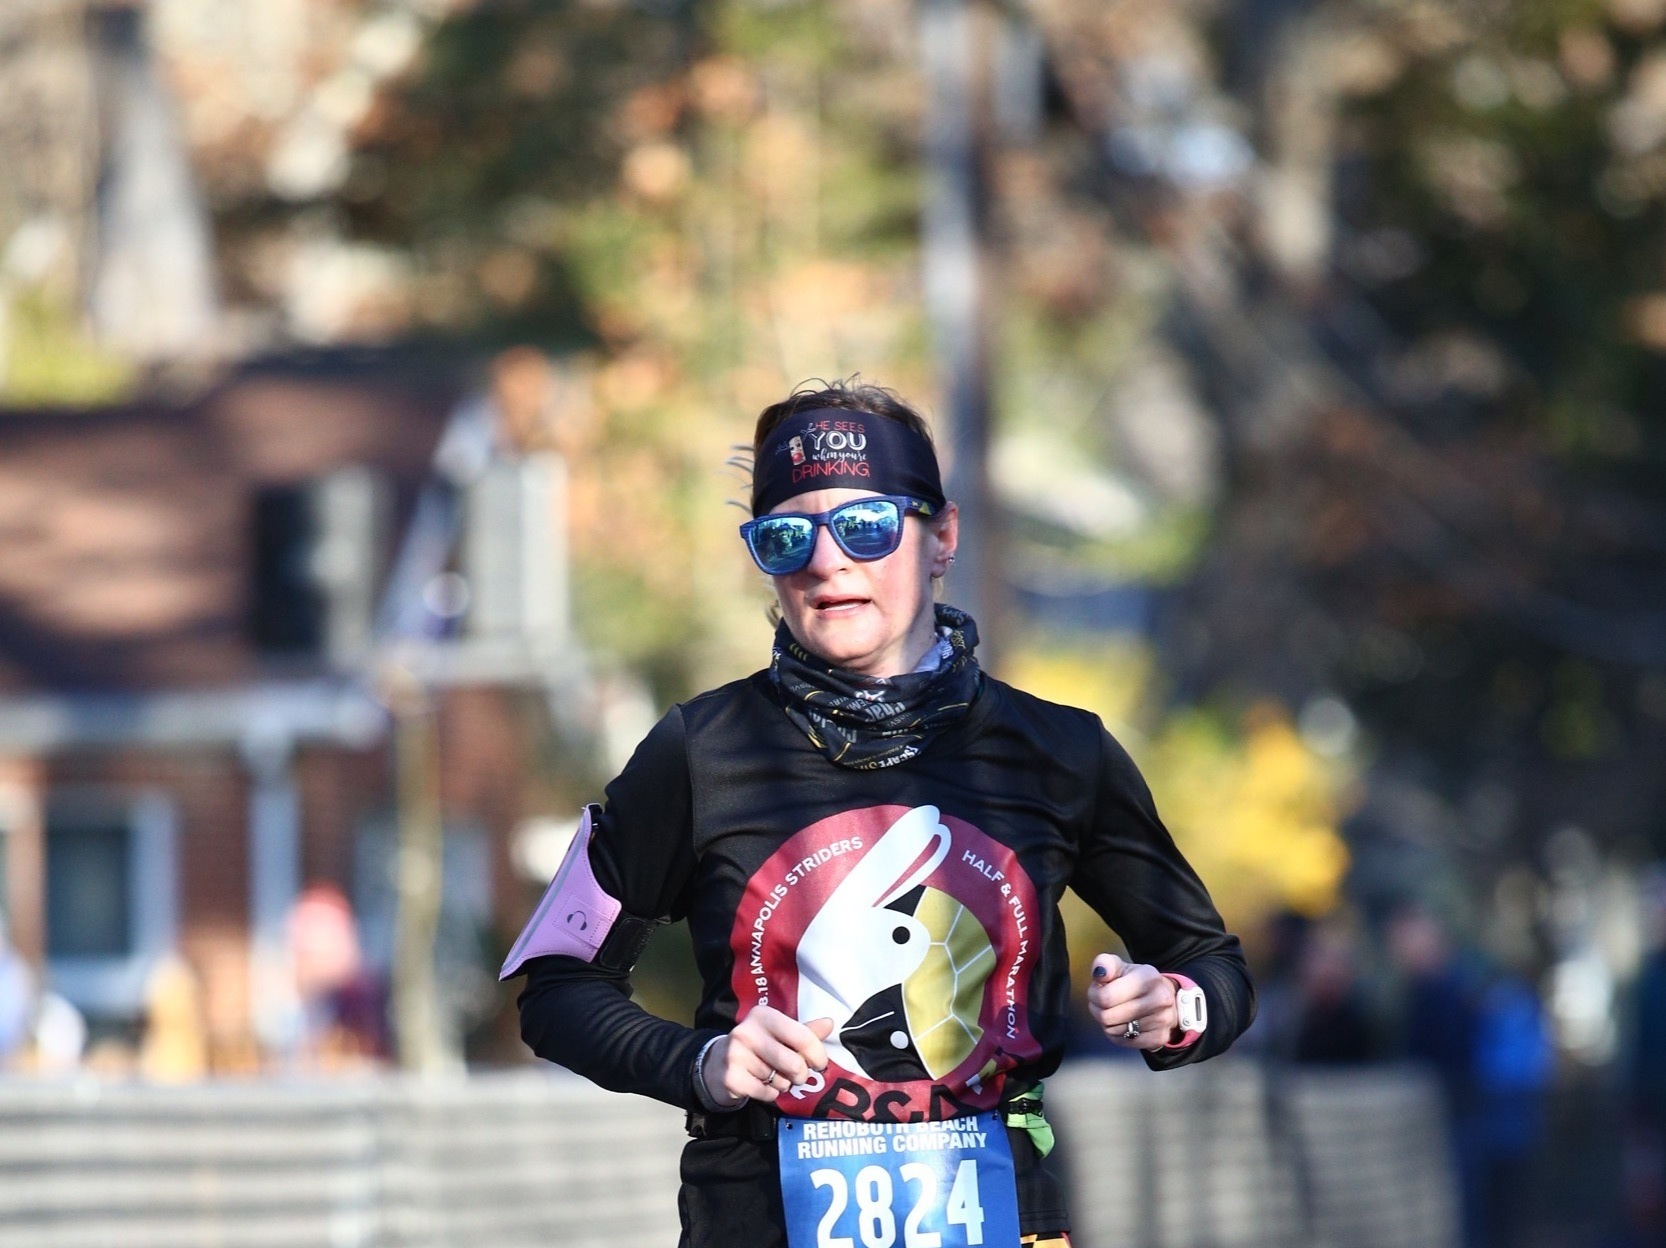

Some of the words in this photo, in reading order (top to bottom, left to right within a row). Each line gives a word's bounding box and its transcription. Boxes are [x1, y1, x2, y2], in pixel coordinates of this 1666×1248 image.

[815, 420, 831, 430] HE
[834, 421, 865, 433] SEES
[809, 430, 867, 450] YOU
[812, 448, 838, 461] when
[792, 461, 870, 483] DRINKING
[879, 745, 919, 768] ESCAPE
[962, 849, 1005, 883] HALF
[1000, 883, 1012, 898] &
[750, 883, 788, 974] ANNAPOLIS
[789, 836, 864, 886] STRIDERS
[1008, 895, 1028, 939] FULL
[1006, 940, 1028, 1039] MARATHON
[797, 1138, 887, 1159] RUNNING
[893, 1132, 987, 1152] COMPANY
